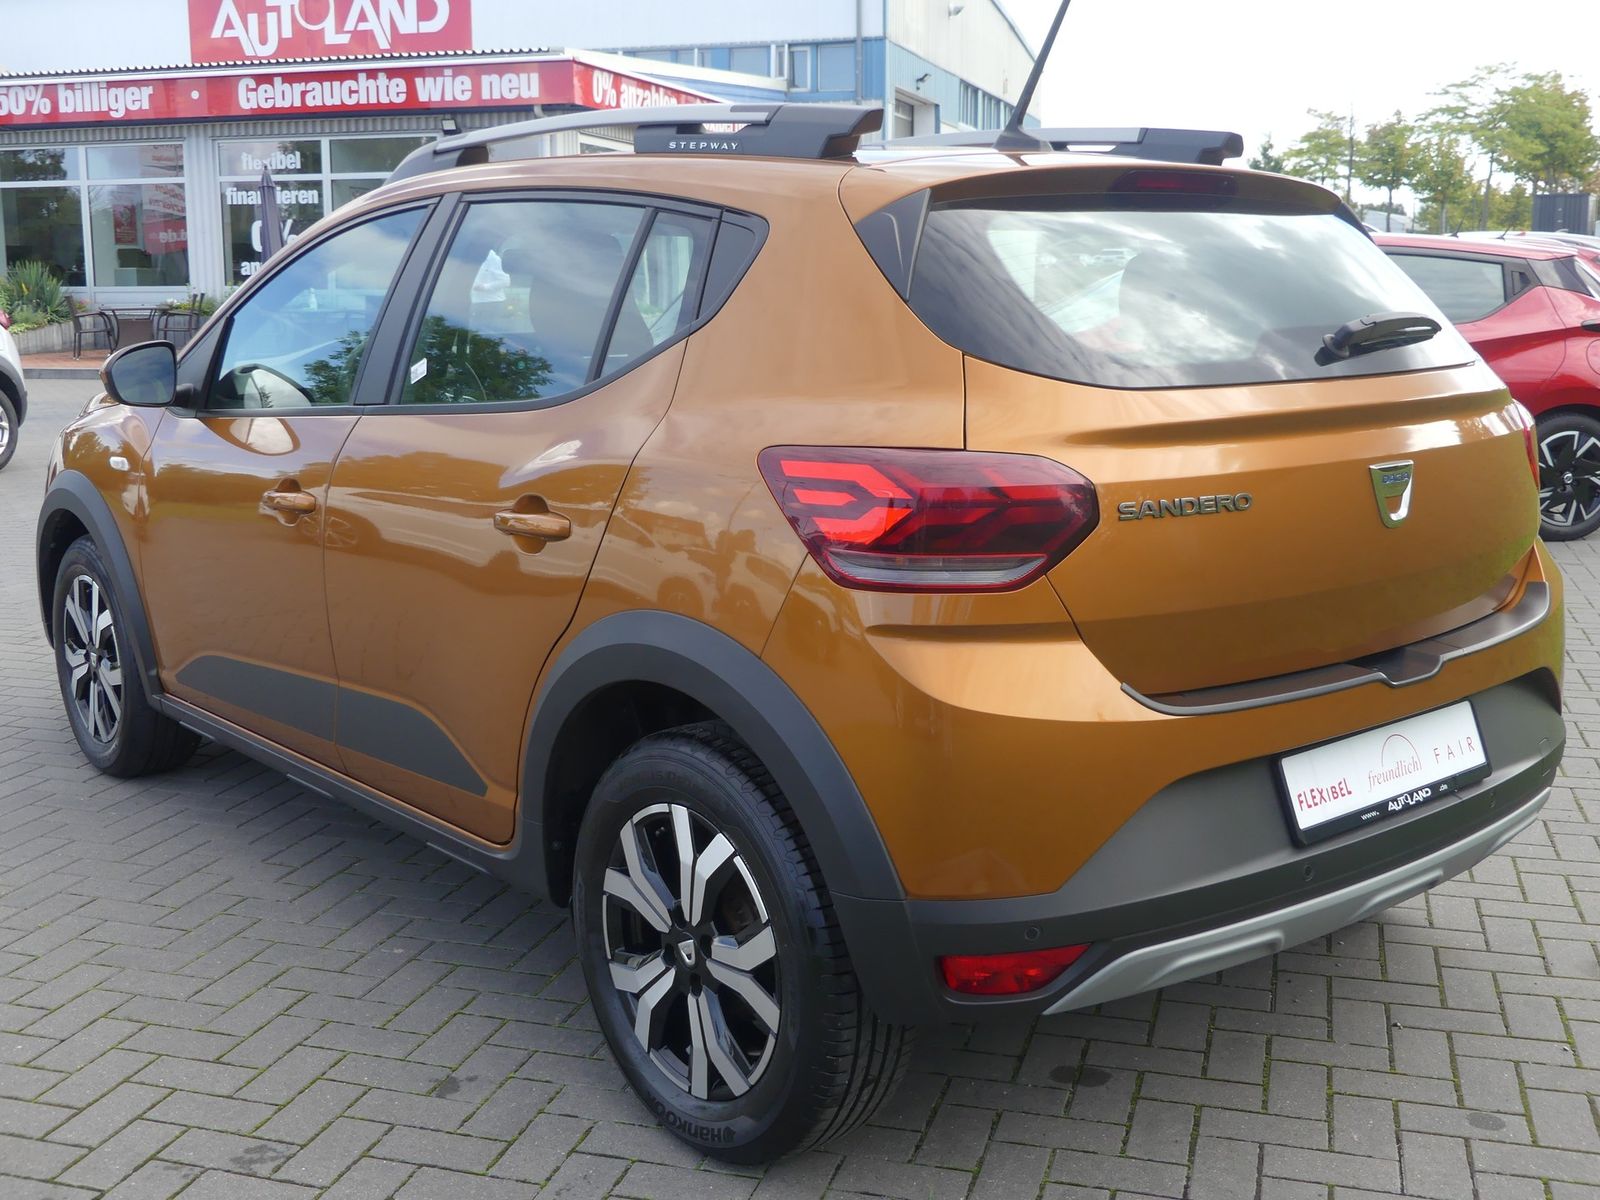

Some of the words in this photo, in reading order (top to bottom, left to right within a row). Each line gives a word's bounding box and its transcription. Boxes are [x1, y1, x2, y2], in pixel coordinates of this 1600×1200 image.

[211, 0, 450, 56] AUTOLAND
[58, 81, 153, 118] billiger
[238, 72, 407, 109] Gebrauchte
[415, 69, 472, 101] wie
[481, 72, 540, 98] neu
[592, 70, 617, 107] 0%
[241, 151, 301, 170] flexibel
[669, 141, 739, 150] STEPWAY
[226, 187, 319, 205] finaieren
[1118, 492, 1252, 521] SANDERO
[1297, 778, 1352, 811] FLEXIBEL
[1368, 756, 1420, 792] freundlich
[1434, 736, 1475, 764] FAIR
[1387, 787, 1432, 812] AUTOLAND
